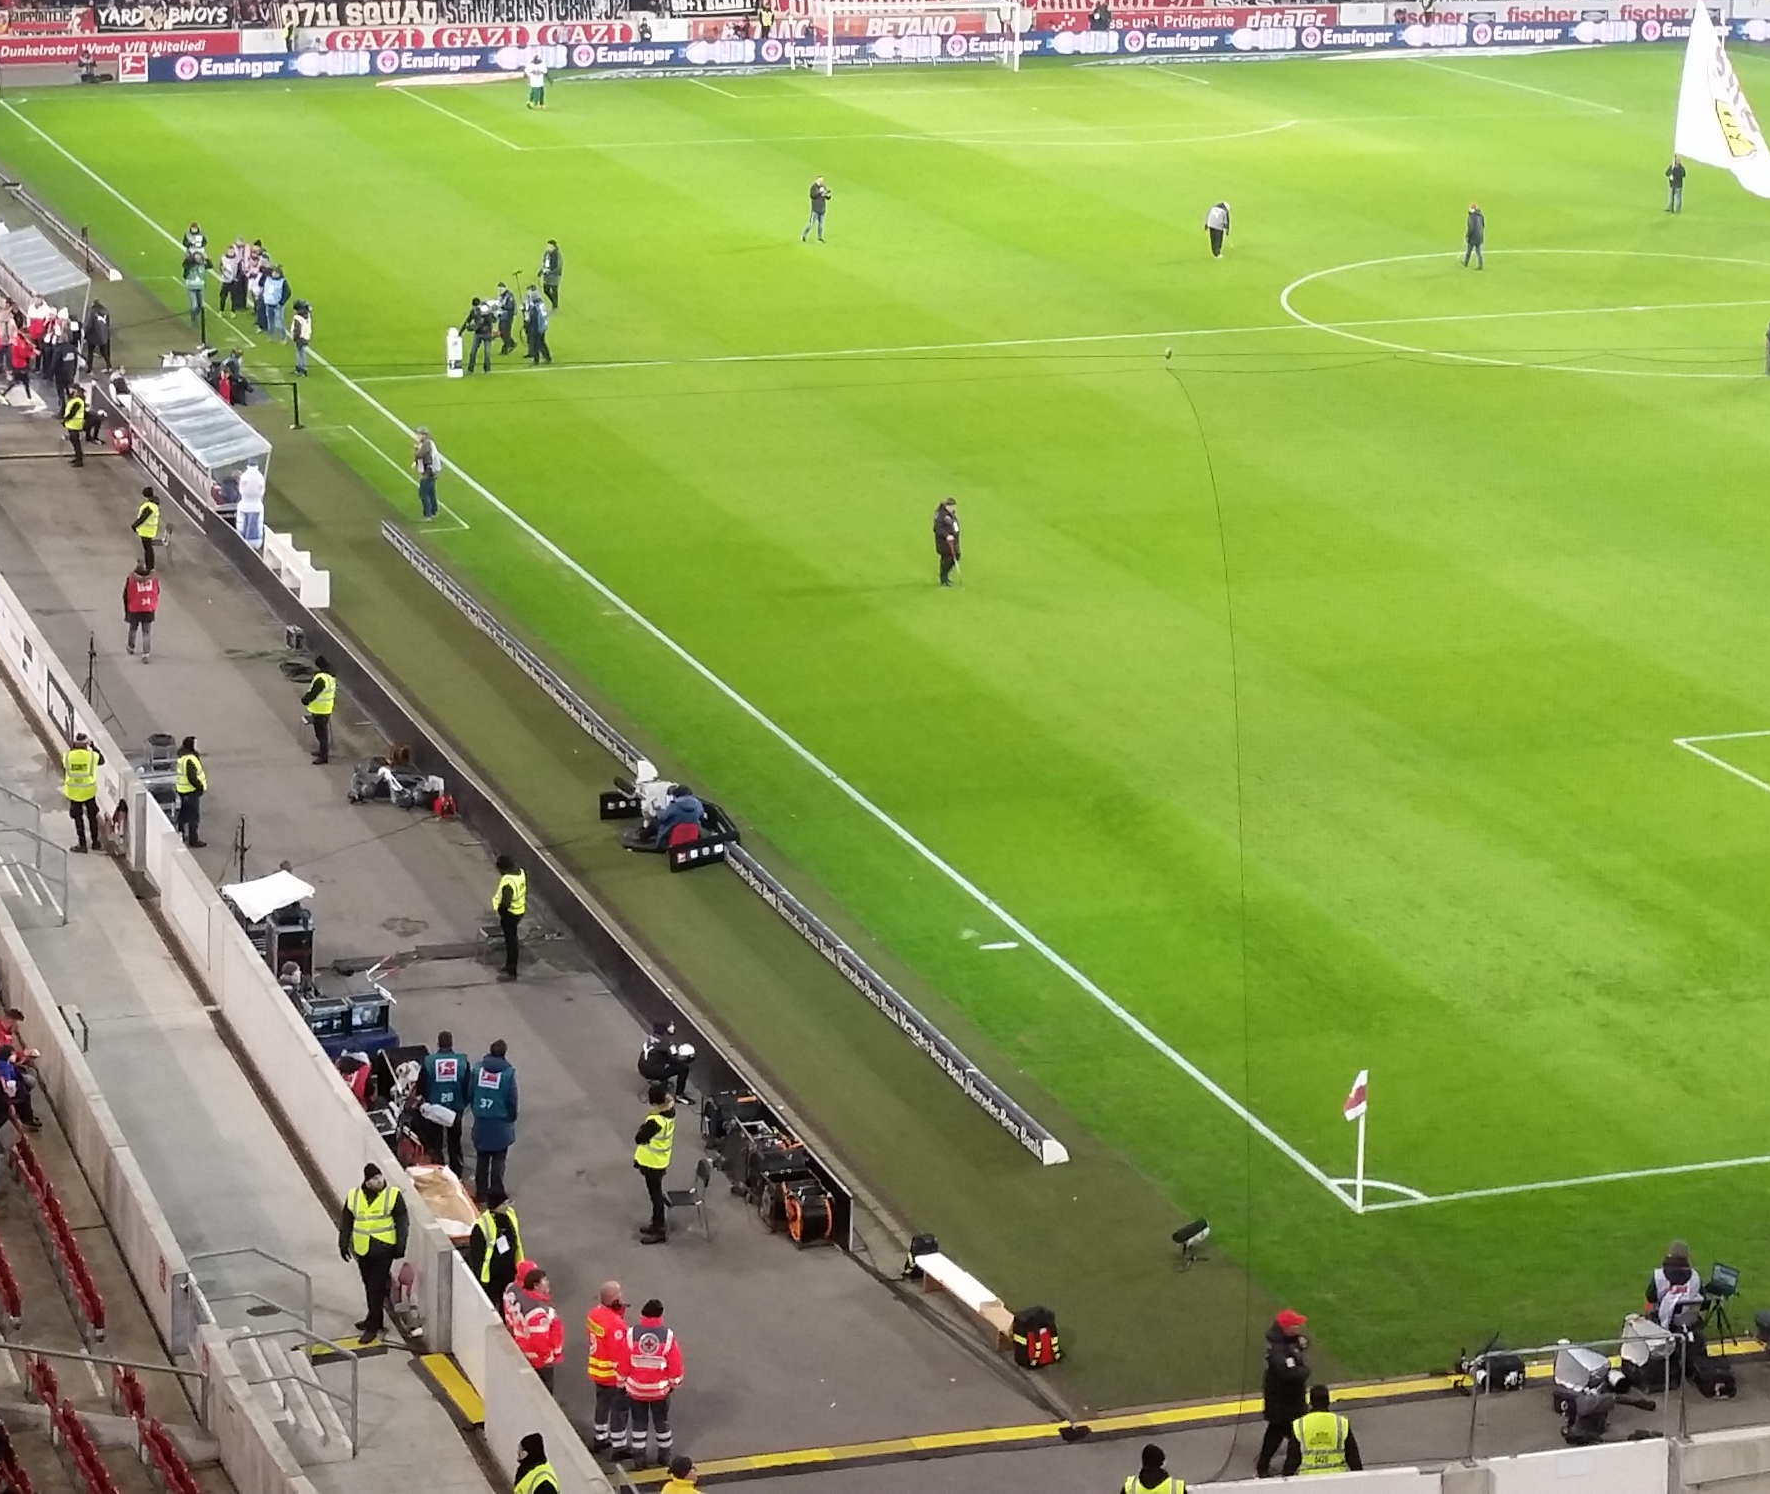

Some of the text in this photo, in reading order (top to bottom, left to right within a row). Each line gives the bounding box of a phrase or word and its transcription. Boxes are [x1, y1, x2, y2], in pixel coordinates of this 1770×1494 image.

[100, 5, 228, 26] YARD BWOYS
[280, 0, 439, 26] 0711 SQUAD
[1163, 13, 1235, 31] Prüfgeräte
[1507, 5, 1577, 24] fischer
[1620, 3, 1689, 22] fischer
[865, 16, 957, 37] BETANO
[1492, 25, 1563, 45] Ensinger
[1145, 32, 1219, 51] Ensinger
[1322, 27, 1394, 47] Ensinger
[0, 42, 78, 58] Dunkelroter!
[81, 40, 122, 56] Werde
[124, 39, 148, 55] VfB
[150, 38, 207, 55] Mitglied!
[595, 46, 675, 65] Ensinger
[968, 38, 1042, 57] Ensinger
[198, 57, 283, 78] Ensinger
[400, 52, 482, 72] Ensinger
[440, 1091, 454, 1103] 28
[479, 1098, 494, 1109] 37
[964, 1077, 1021, 1140] Mercedes-Benz
